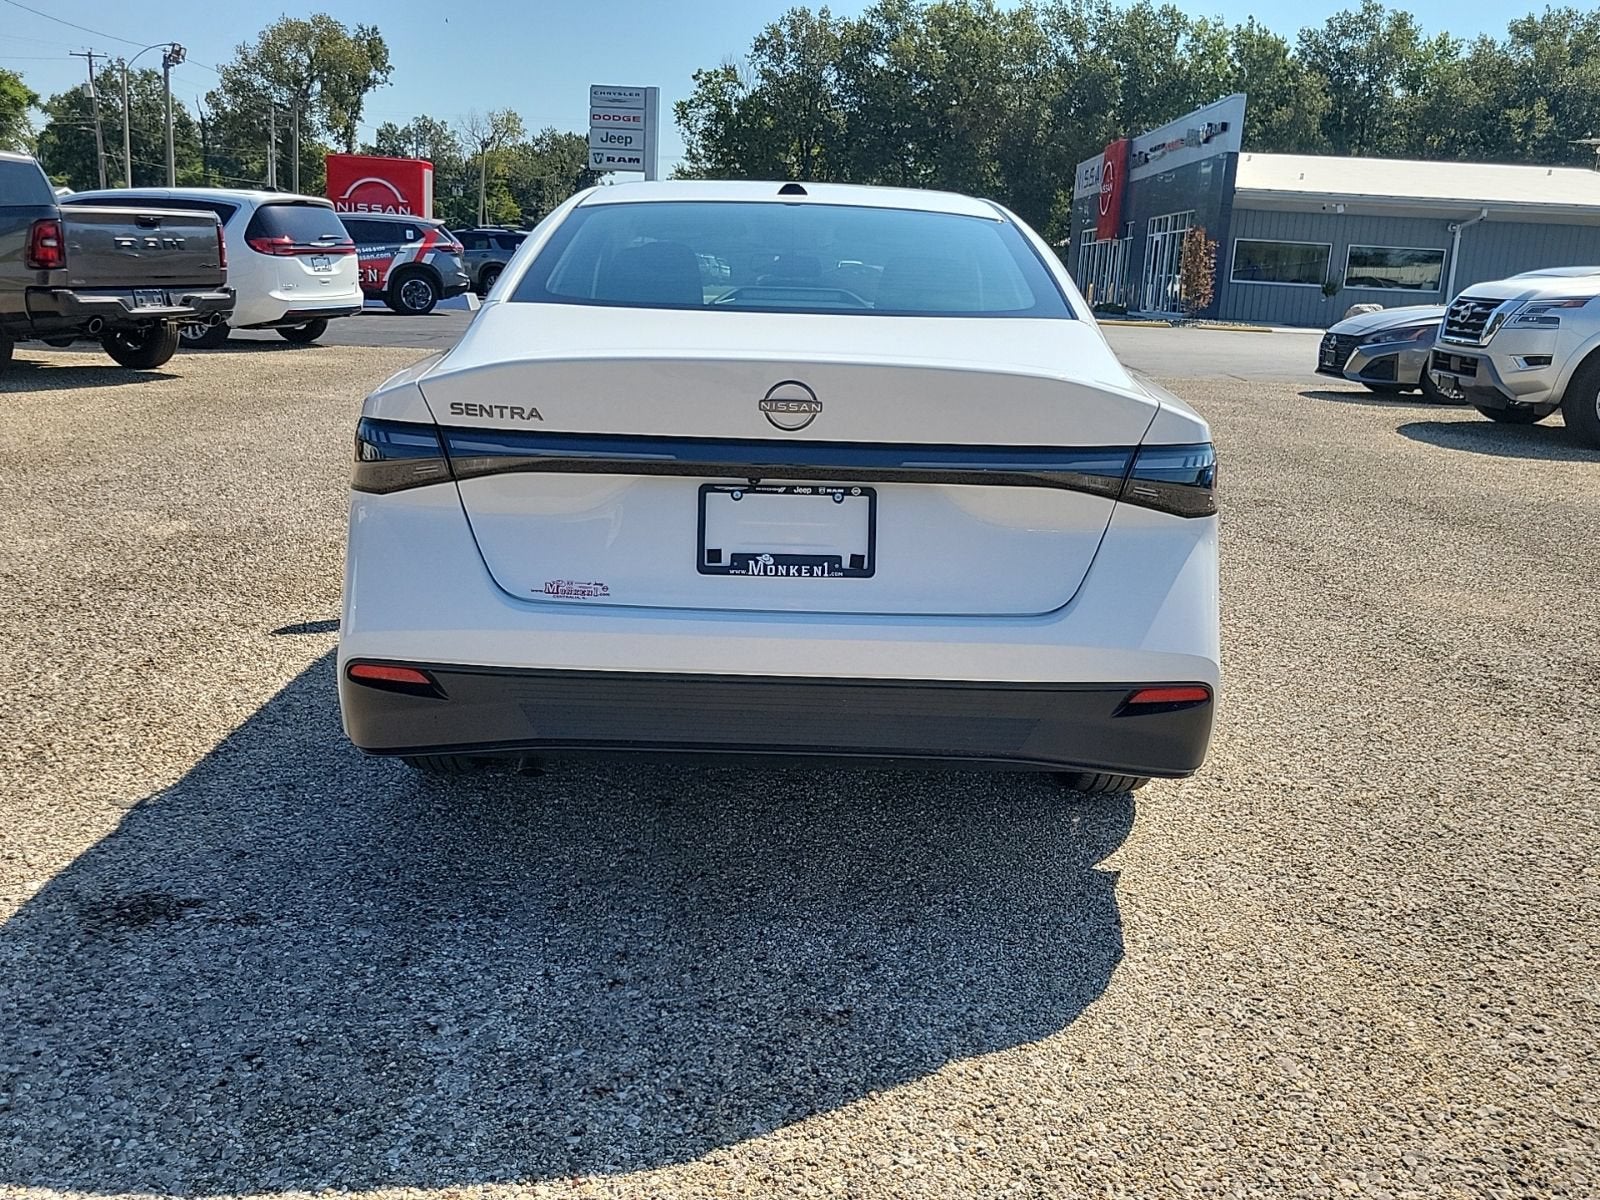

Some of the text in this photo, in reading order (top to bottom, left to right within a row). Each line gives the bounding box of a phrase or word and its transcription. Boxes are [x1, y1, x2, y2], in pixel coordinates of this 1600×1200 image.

[593, 90, 640, 98] CHRYSLER
[592, 114, 641, 123] DODGE
[600, 131, 633, 147] Jeep
[606, 156, 641, 164] RAM
[337, 201, 411, 216] NISSAN
[114, 237, 185, 250] RAM
[450, 401, 544, 422] SENTRA
[760, 401, 822, 413] NISSAN
[793, 486, 812, 495] Jeep
